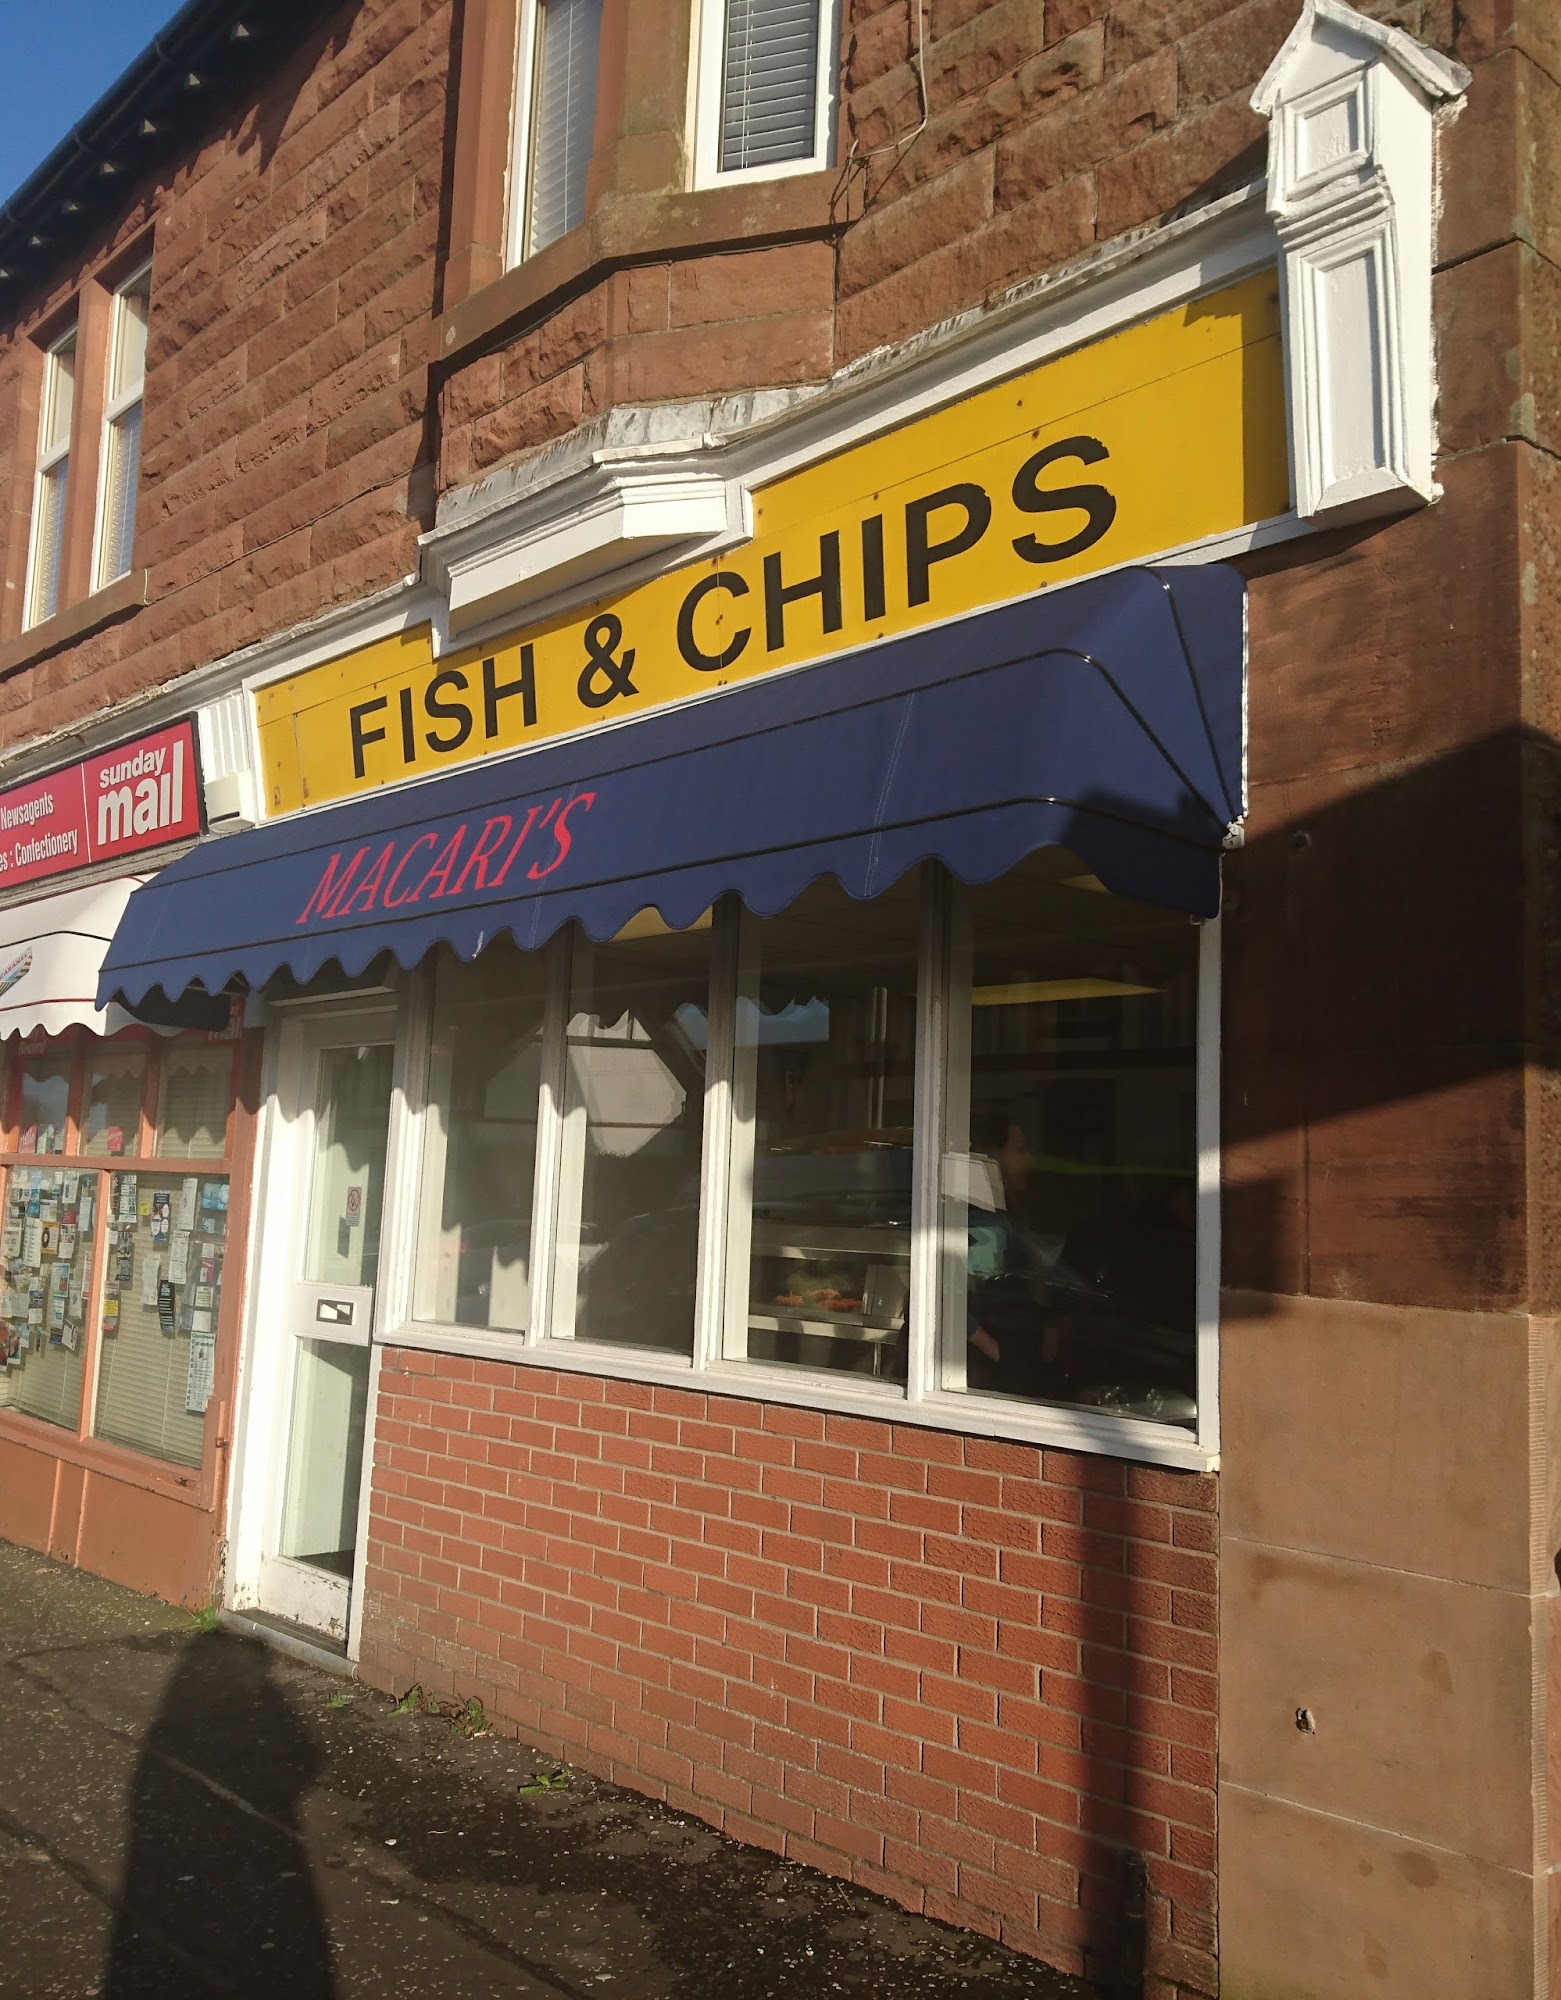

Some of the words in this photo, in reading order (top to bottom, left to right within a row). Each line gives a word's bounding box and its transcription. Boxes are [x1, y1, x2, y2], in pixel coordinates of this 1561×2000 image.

[350, 643, 538, 779] FISH
[576, 613, 640, 709] &
[676, 435, 1118, 672] CHIPS
[97, 740, 184, 846] mail
[99, 747, 167, 789] sunday
[0, 791, 54, 831] Newsagents
[15, 829, 78, 867] Confectionery
[296, 792, 598, 925] MACARI'S
